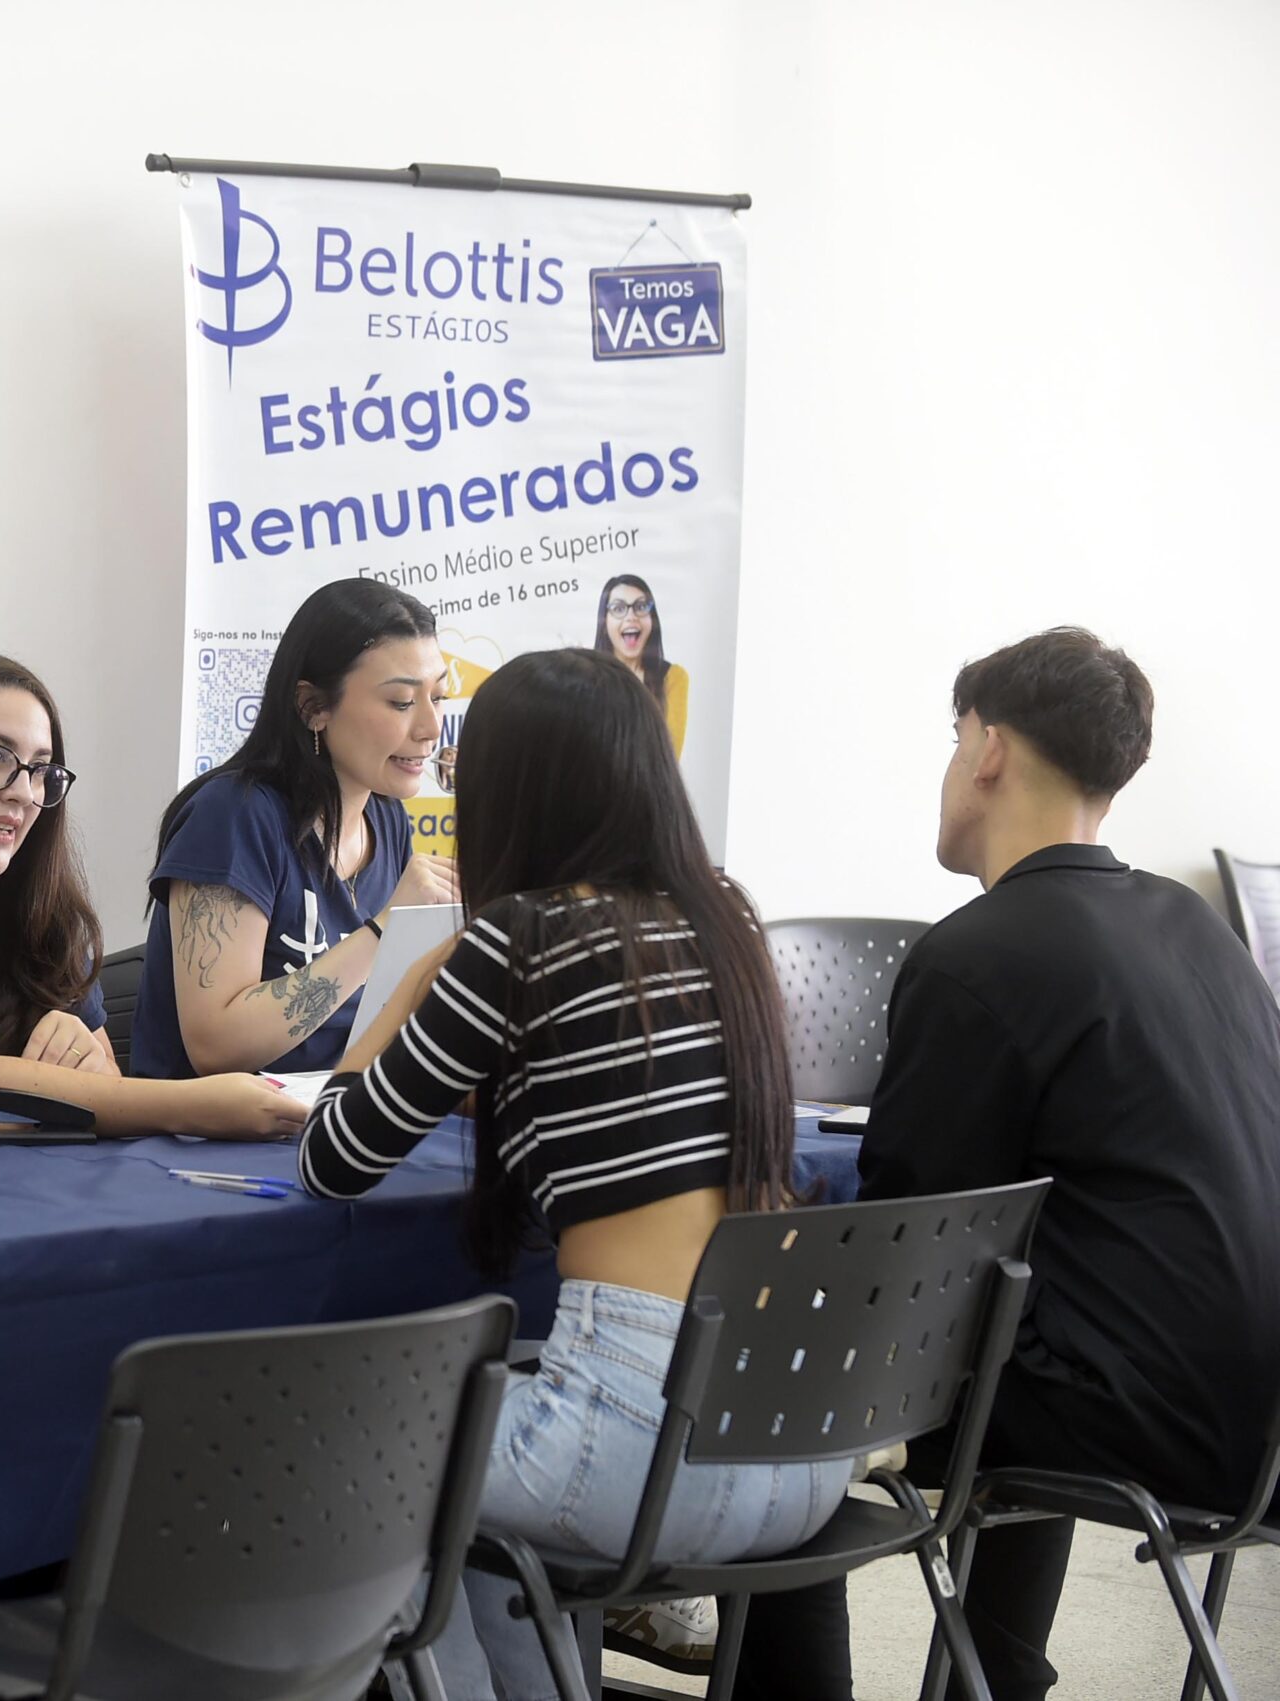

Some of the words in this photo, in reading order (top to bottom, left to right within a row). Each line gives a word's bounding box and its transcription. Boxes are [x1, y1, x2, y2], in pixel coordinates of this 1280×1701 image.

[315, 226, 564, 306] Belottis
[619, 277, 695, 300] Temos
[368, 310, 509, 344] ESTÁGIOS
[597, 301, 720, 350] VAGA
[259, 370, 532, 455] Estágios
[207, 441, 700, 564] Remunerados
[444, 545, 514, 580] Médio
[520, 545, 533, 565] e
[539, 527, 640, 564] Superior
[428, 598, 473, 618] cima
[478, 589, 501, 608] de
[508, 584, 528, 602] 16
[534, 578, 579, 599] anos
[242, 631, 257, 641] no
